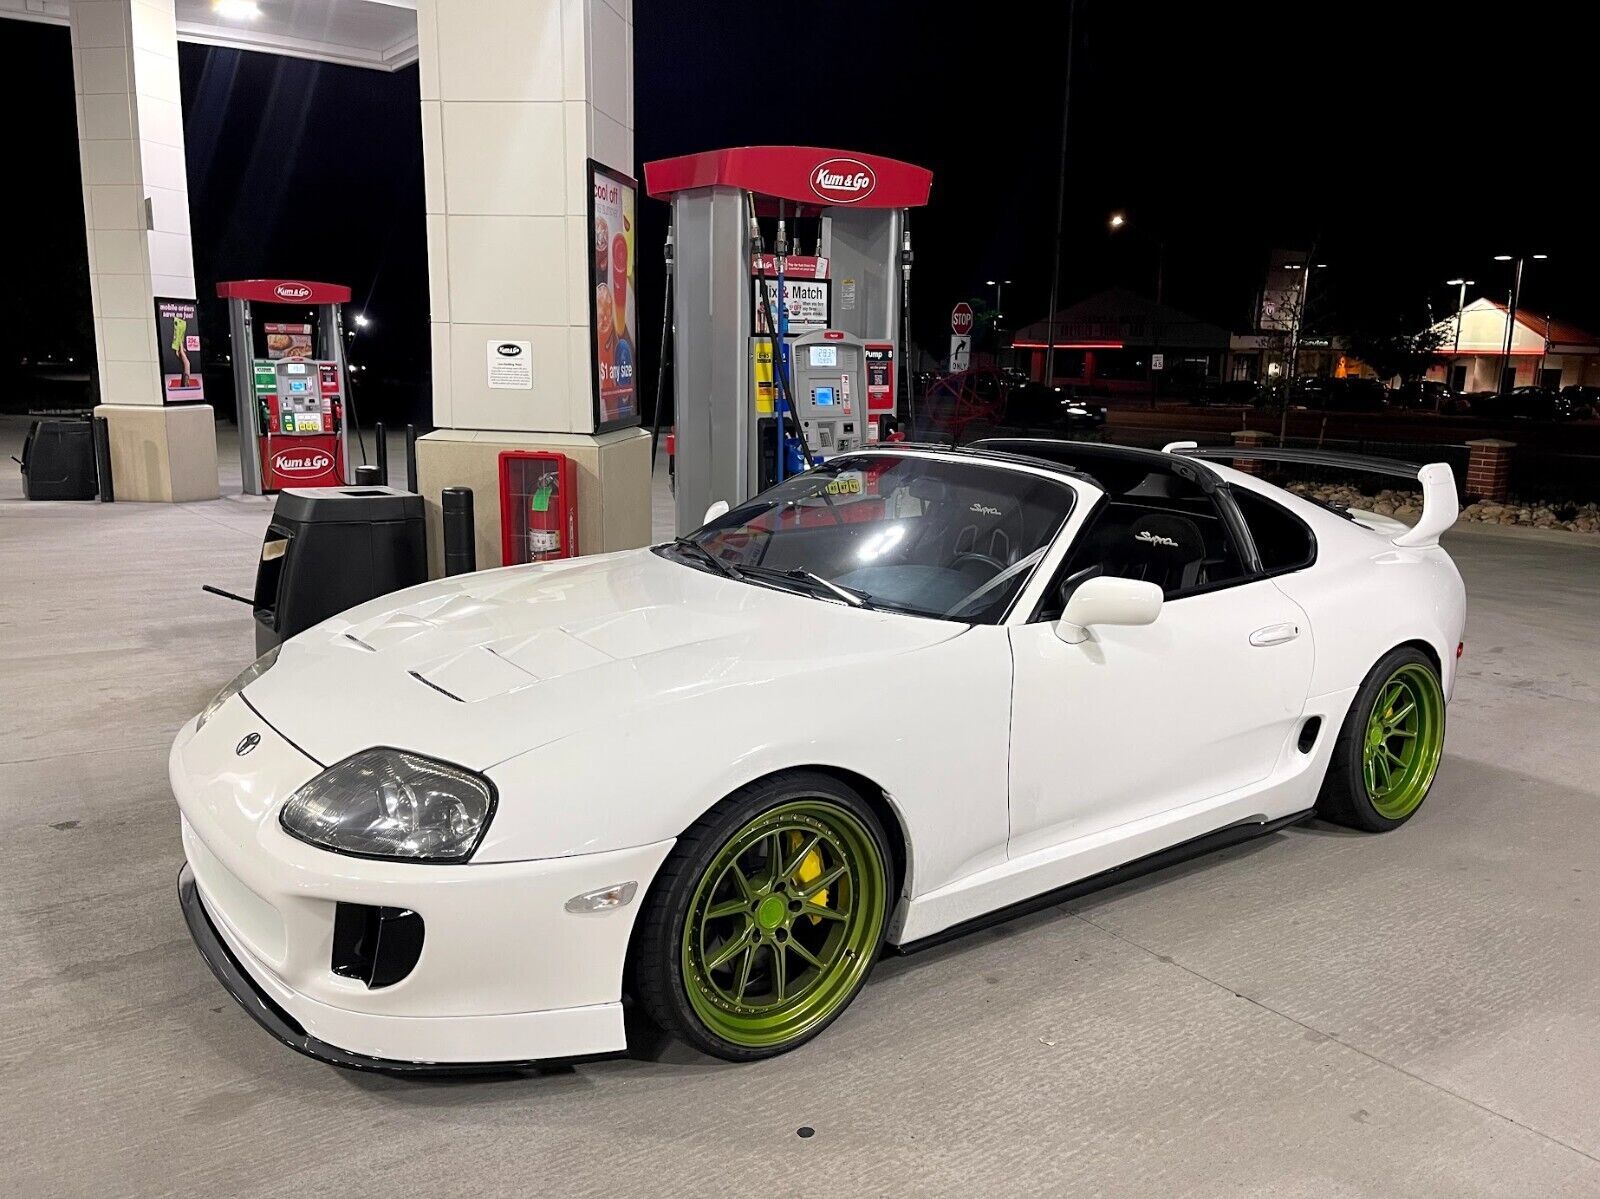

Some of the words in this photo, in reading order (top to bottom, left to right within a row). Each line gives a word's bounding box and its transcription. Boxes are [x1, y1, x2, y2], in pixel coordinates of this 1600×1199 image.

[816, 169, 844, 189] Kum
[844, 174, 853, 187] &
[853, 172, 870, 190] Go
[595, 184, 608, 201] cool
[610, 187, 618, 204] off
[277, 287, 293, 296] Kum
[299, 288, 309, 297] Go
[792, 286, 823, 300] Match
[953, 313, 971, 326] STOP
[865, 350, 882, 360] Pump
[887, 350, 893, 359] 8
[610, 365, 620, 382] any
[620, 361, 633, 378] size
[276, 456, 303, 470] Kum
[304, 457, 312, 468] &
[312, 455, 329, 470] Go
[969, 503, 1002, 516] Supra
[1134, 530, 1179, 547] Supra
